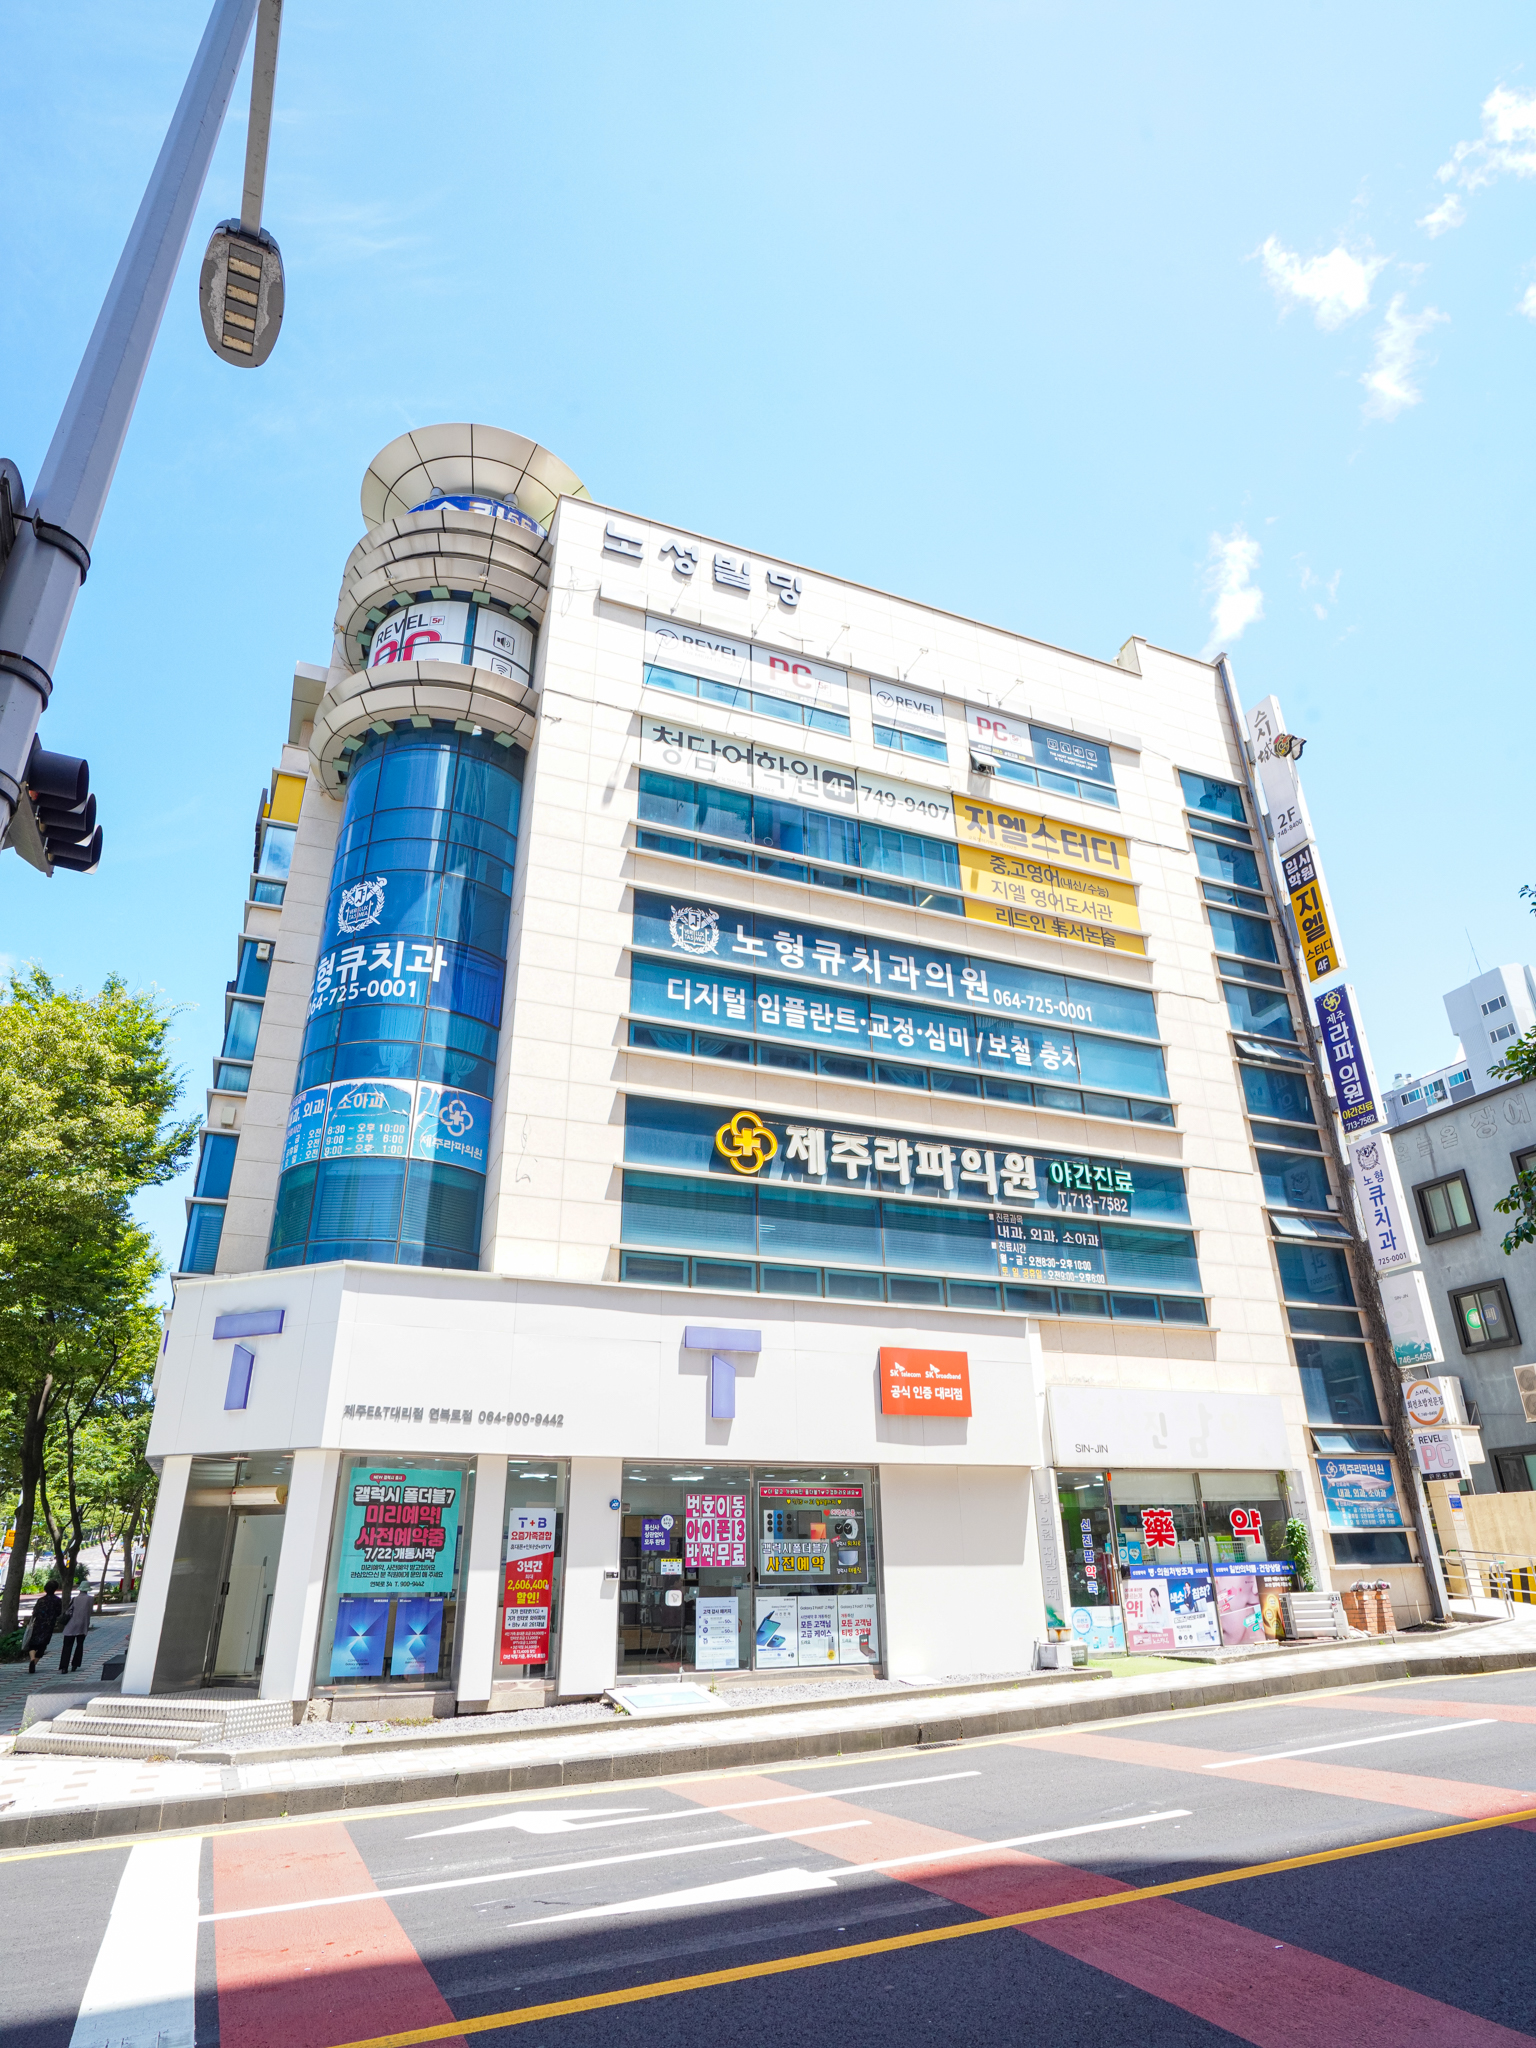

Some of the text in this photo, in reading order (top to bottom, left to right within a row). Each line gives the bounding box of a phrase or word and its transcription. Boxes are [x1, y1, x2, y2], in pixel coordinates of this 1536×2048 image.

[603, 520, 803, 606] 노성빌딩
[376, 614, 444, 647] REVEL 5F
[682, 635, 741, 662] REVEL
[769, 655, 812, 690] PC
[896, 696, 939, 716] REVEL
[976, 716, 1008, 742] PC
[652, 726, 819, 797] 청담어학원
[826, 777, 853, 798] 4F
[861, 785, 949, 821] 749-9407
[1277, 806, 1296, 828] 2F
[964, 805, 1120, 870] 지엘스터디
[1285, 850, 1311, 876] 입시
[1288, 864, 1314, 887] 학원
[991, 879, 1113, 923] 지엘 영어도서관
[1296, 886, 1326, 943] 지엘
[995, 907, 1117, 949] 리드인 독서논술
[1307, 938, 1333, 961] 스터디
[732, 924, 1093, 1022] 노형큐치과의원 064-725-0001
[1317, 958, 1328, 971] 4F
[667, 978, 746, 1020] 디지털
[988, 1033, 1032, 1067] 보철
[1326, 1011, 1346, 1025] 제주
[1328, 1024, 1365, 1106] 라파의원
[1342, 1101, 1374, 1120] 야간진료
[308, 1127, 322, 1140] 오전
[327, 1124, 346, 1135] 8:30
[357, 1122, 375, 1133] 오후
[380, 1123, 406, 1134] 10:00
[1346, 1115, 1376, 1130] 713-7582
[325, 1134, 345, 1146] 9:00
[356, 1133, 374, 1143] 오후
[382, 1134, 404, 1144] 6:00
[382, 1144, 403, 1154] 1:00
[785, 1125, 1040, 1199] 제주라파의원
[1049, 1160, 1135, 1194] 야간진료
[1363, 1170, 1384, 1186] 노형
[1058, 1191, 1129, 1213] T.713-7582
[1368, 1185, 1397, 1251] 큐치과
[997, 1224, 1099, 1247] 내과, 외과, 소아과
[998, 1241, 1027, 1254] 진료시간
[1000, 1253, 1008, 1265] 월
[1015, 1255, 1023, 1266] 금
[1378, 1252, 1407, 1266] 725-0001
[1022, 1268, 1042, 1280] 공휴일
[684, 1325, 762, 1418] T
[890, 1385, 963, 1401] 공식 인증 대리점
[1075, 1443, 1109, 1453] SIN-JIN
[1418, 1434, 1443, 1445] REVEL
[1420, 1442, 1454, 1470] PC
[1338, 1463, 1385, 1475] 제주라파의원
[354, 1486, 456, 1504] 갤럭시 폴더블7
[365, 1504, 442, 1524] 미리예약!
[687, 1495, 745, 1518] 번호이동
[356, 1527, 445, 1547] 사전예약중
[1141, 1508, 1262, 1548] 藥 약
[365, 1547, 436, 1560] 7/22 개통시작
[686, 1543, 745, 1566] 반짝무료
[762, 1543, 829, 1555] 갤럭시폴더블7
[1080, 1518, 1099, 1596] 신진팜약국
[517, 1560, 543, 1573] 3년간
[766, 1556, 825, 1572] 사전예약
[516, 1592, 540, 1604] 할인!
[1170, 1591, 1185, 1603] 색소
[1126, 1600, 1143, 1617] 약!
[800, 1620, 832, 1628] 모든 고객님
[841, 1618, 872, 1627] 모든 고객님
[841, 1628, 853, 1636] 티빙
[800, 1630, 813, 1638] 고급
